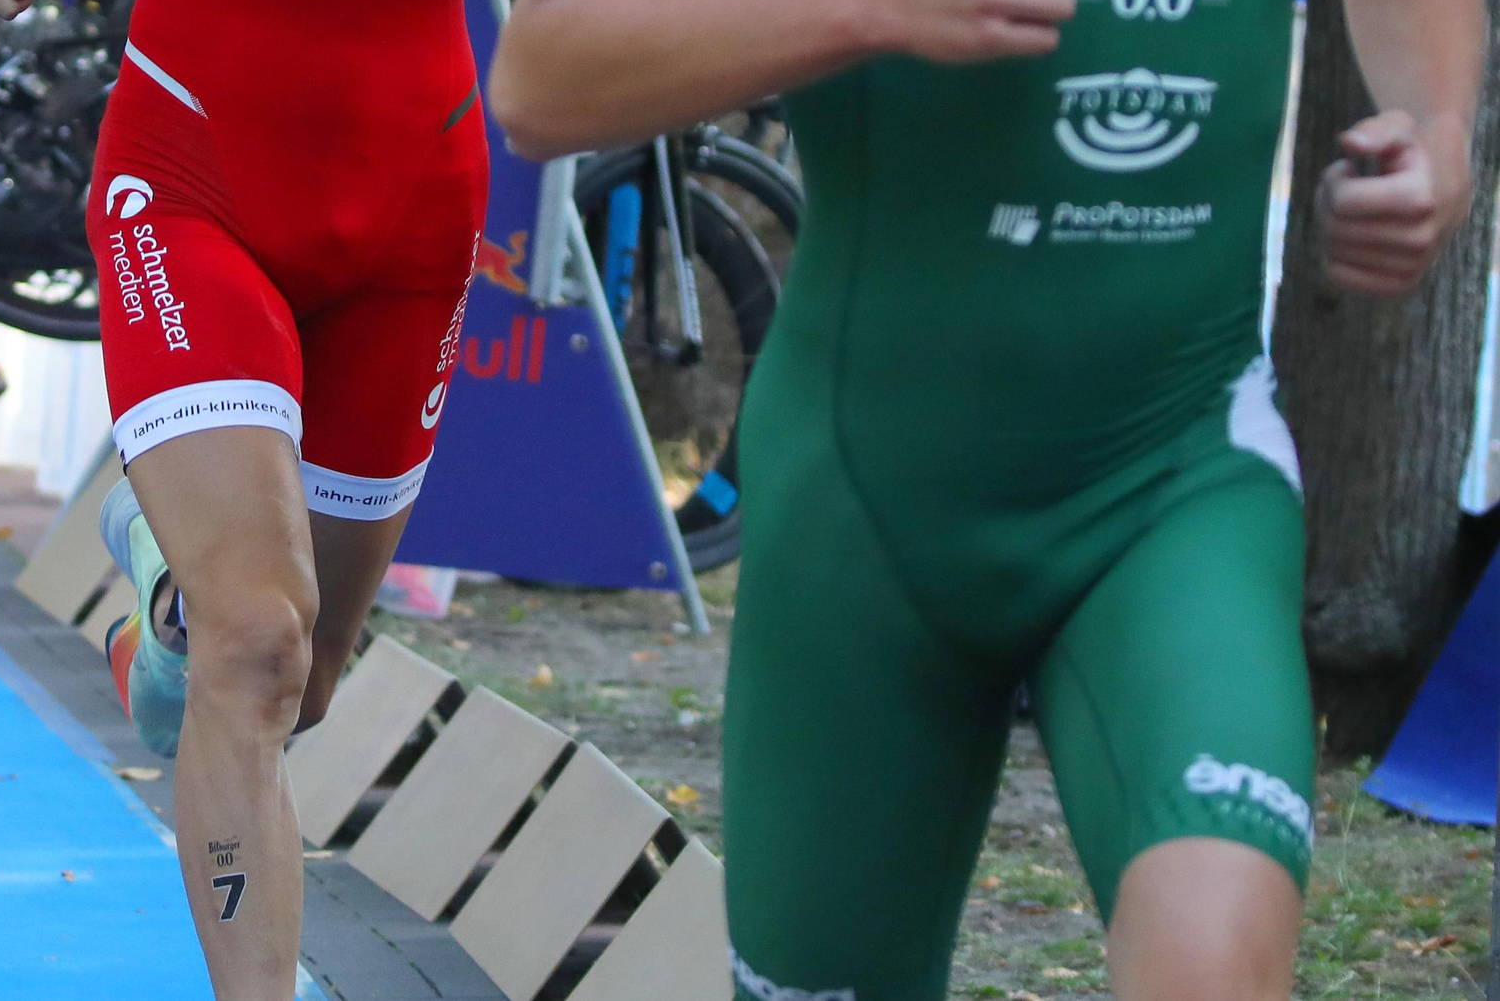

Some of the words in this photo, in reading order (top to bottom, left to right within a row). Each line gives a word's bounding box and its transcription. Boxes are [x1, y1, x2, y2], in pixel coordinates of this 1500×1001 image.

[109, 230, 146, 325] medien
[133, 223, 191, 352] schmelzer
[211, 871, 247, 923] 7
